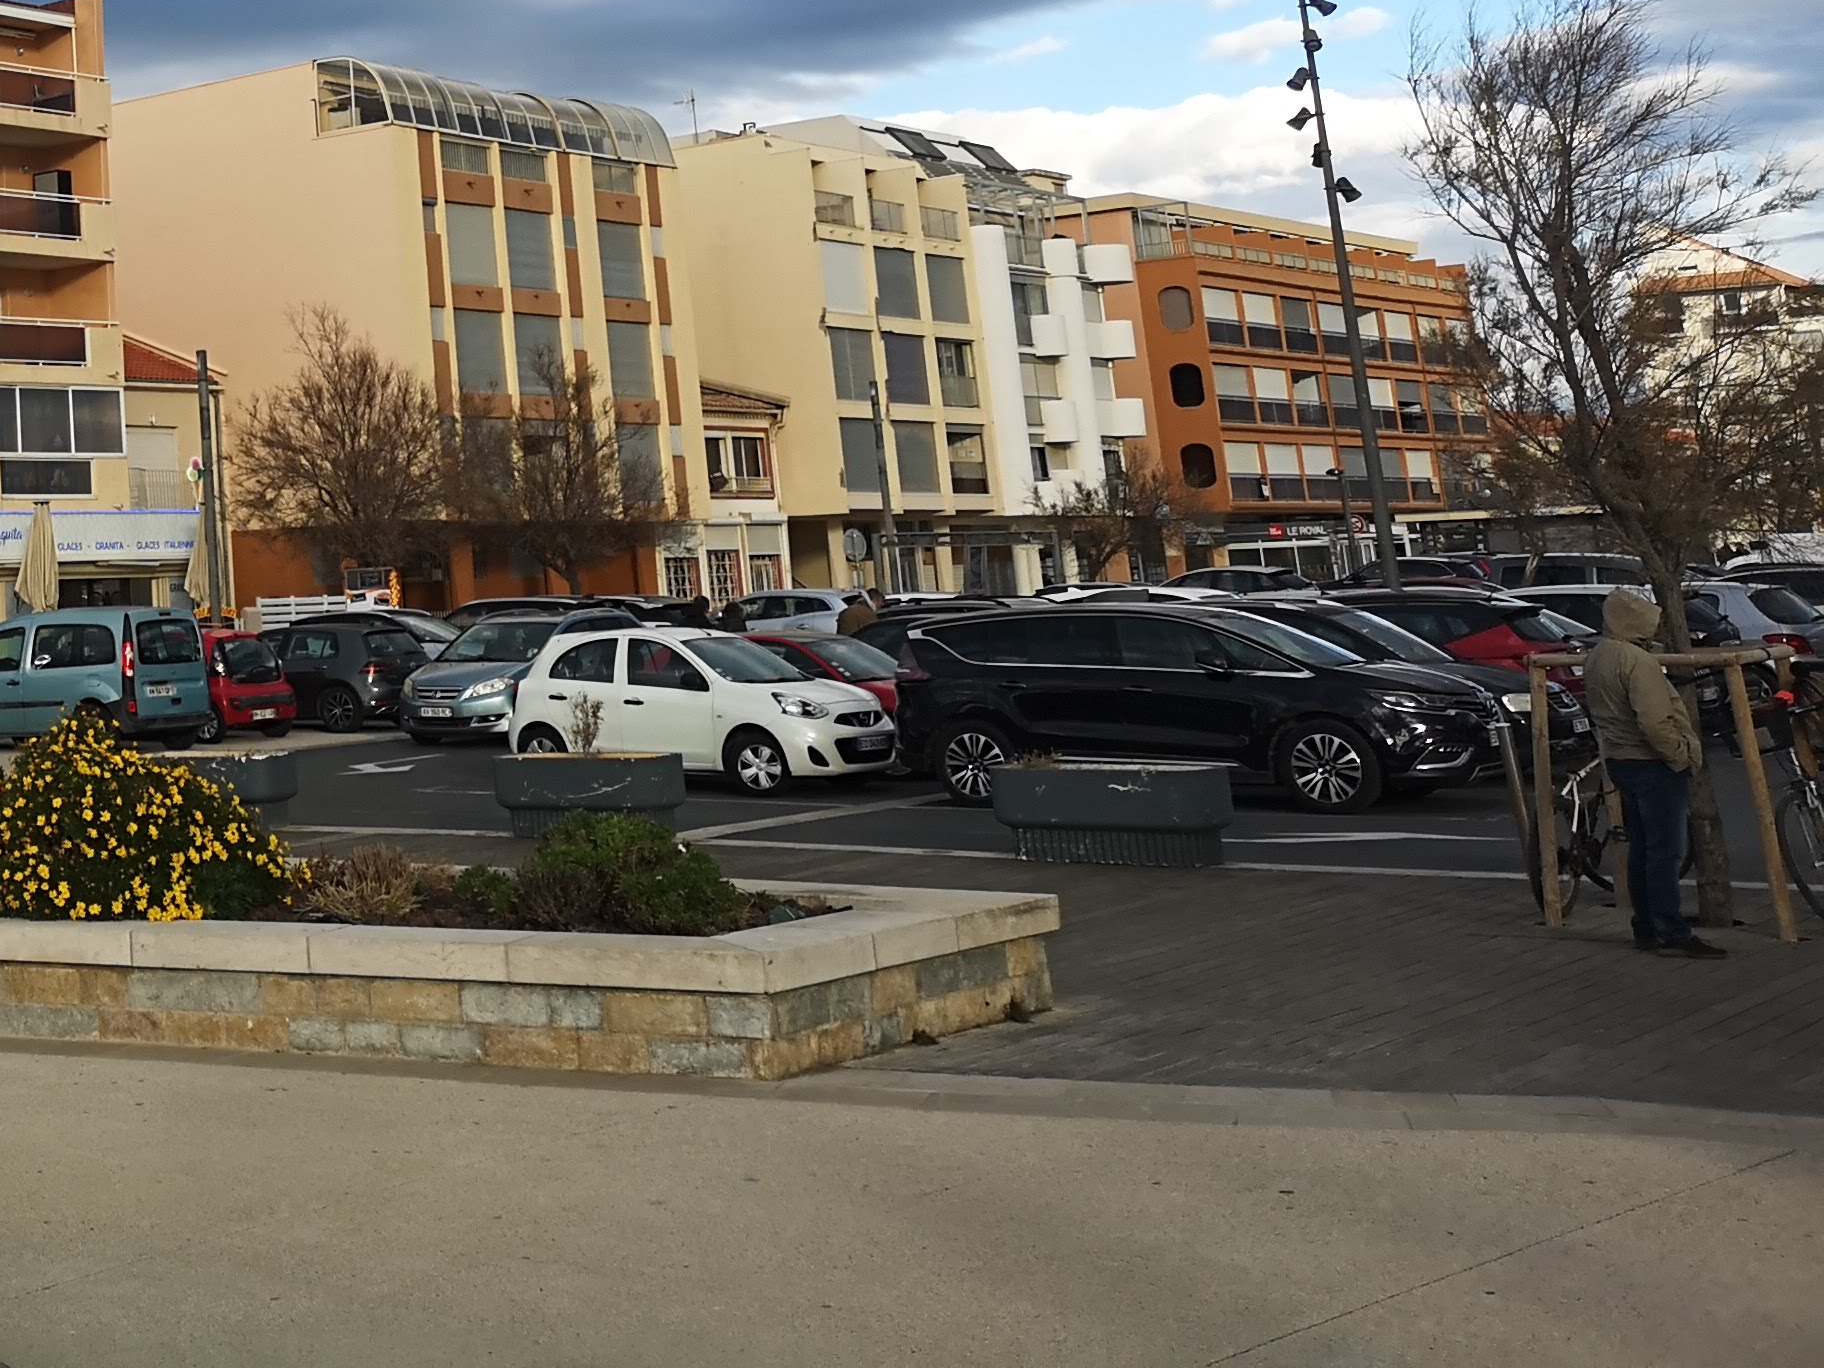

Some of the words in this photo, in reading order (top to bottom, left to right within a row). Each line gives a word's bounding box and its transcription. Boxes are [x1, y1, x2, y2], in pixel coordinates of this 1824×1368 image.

[1287, 527, 1299, 536] LE
[1300, 526, 1327, 535] ROYAL
[57, 542, 83, 551] GLACES
[95, 541, 124, 550] GRANITA
[136, 541, 160, 550] GLACES
